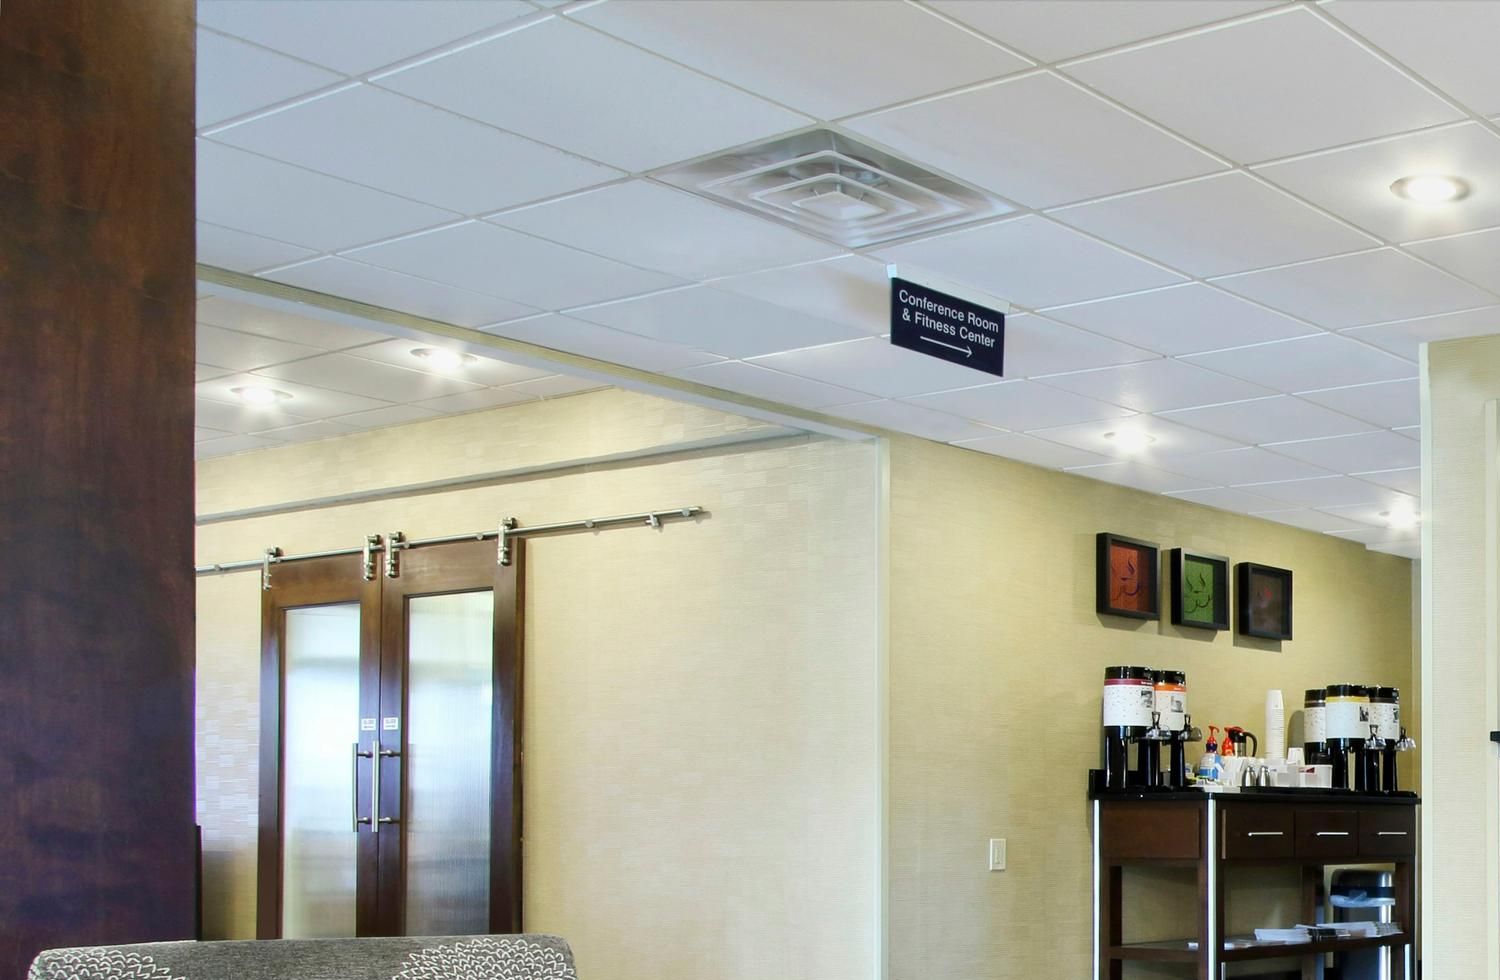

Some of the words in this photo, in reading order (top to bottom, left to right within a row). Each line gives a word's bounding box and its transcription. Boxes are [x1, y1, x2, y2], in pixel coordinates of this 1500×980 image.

[899, 289, 964, 321] Conference
[967, 312, 999, 333] Room
[902, 308, 911, 322] &
[914, 312, 956, 336] Fitness
[959, 326, 996, 348] Center
